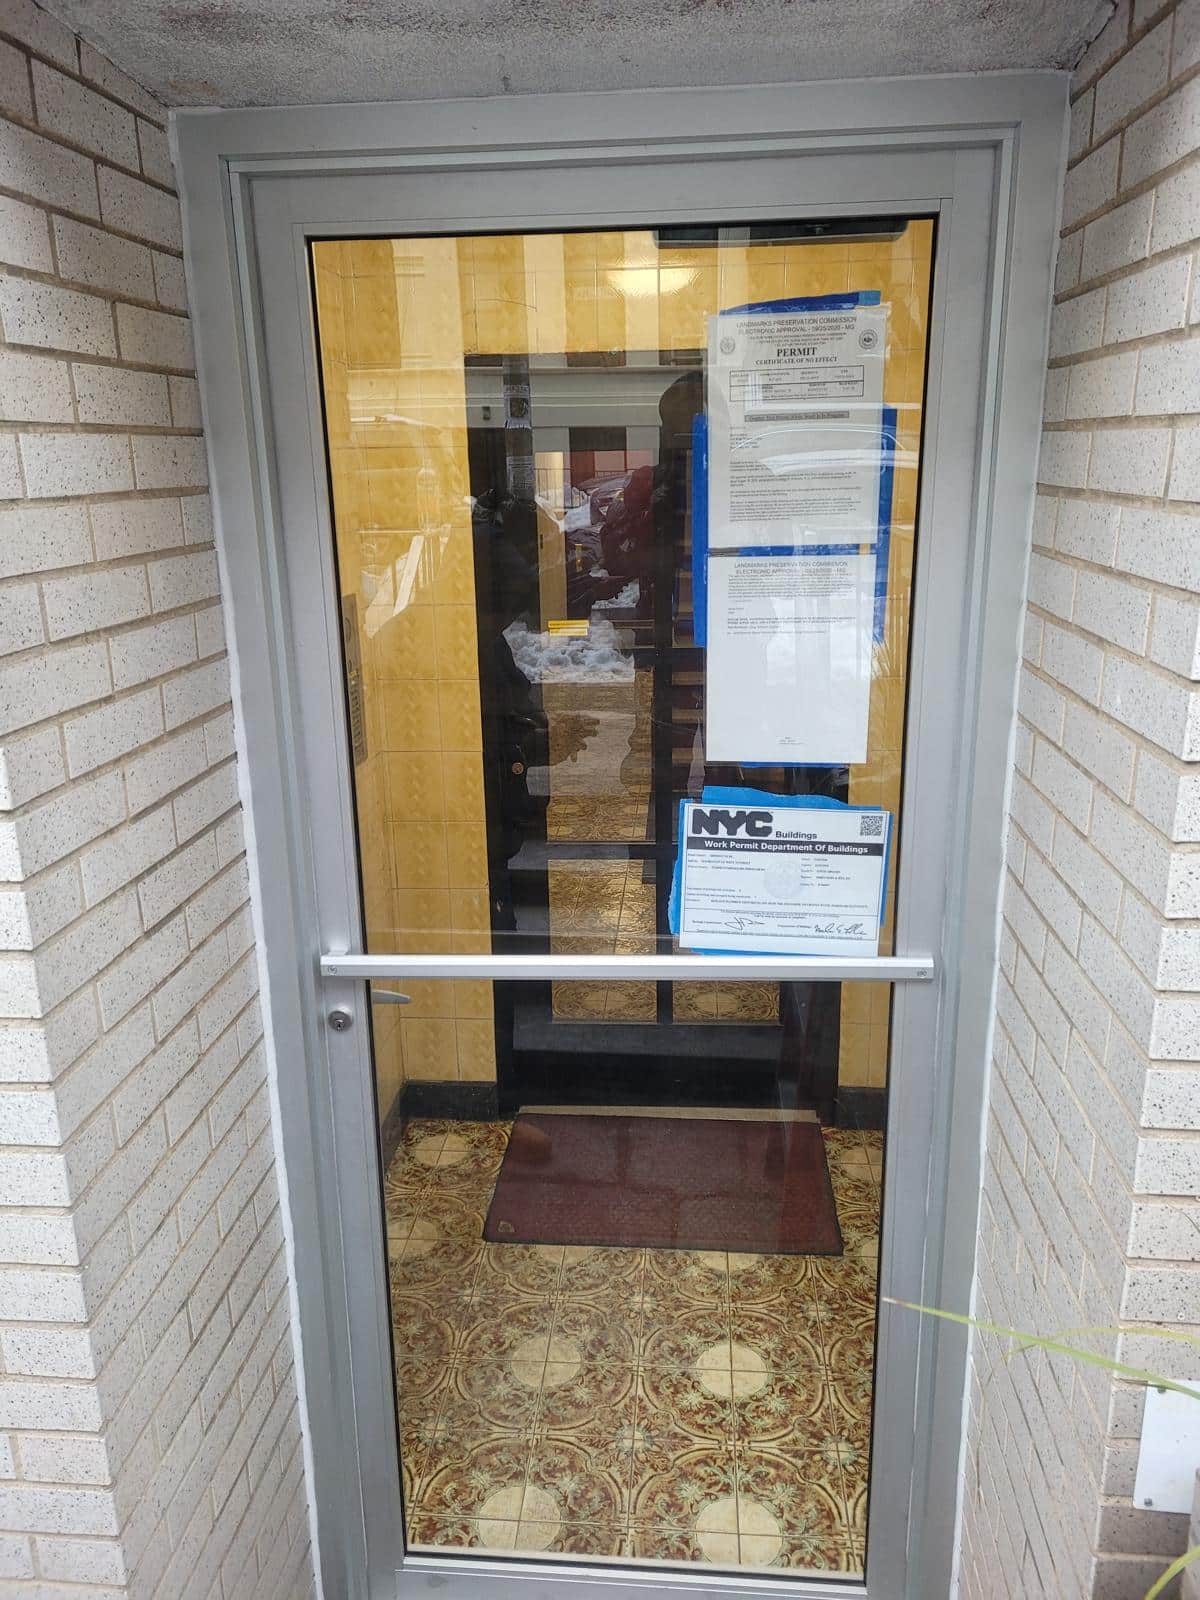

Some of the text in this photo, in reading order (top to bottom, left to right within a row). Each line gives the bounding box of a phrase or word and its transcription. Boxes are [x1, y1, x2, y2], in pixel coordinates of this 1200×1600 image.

[773, 318, 818, 326] PRESERVATION
[819, 316, 857, 324] COMMISSION
[777, 347, 818, 357] PERMIT
[755, 358, 796, 366] CERTIFICATE
[691, 808, 774, 838] NYC
[775, 830, 818, 840] Buildings
[704, 840, 869, 854] Work Permit Department Of Buildings
